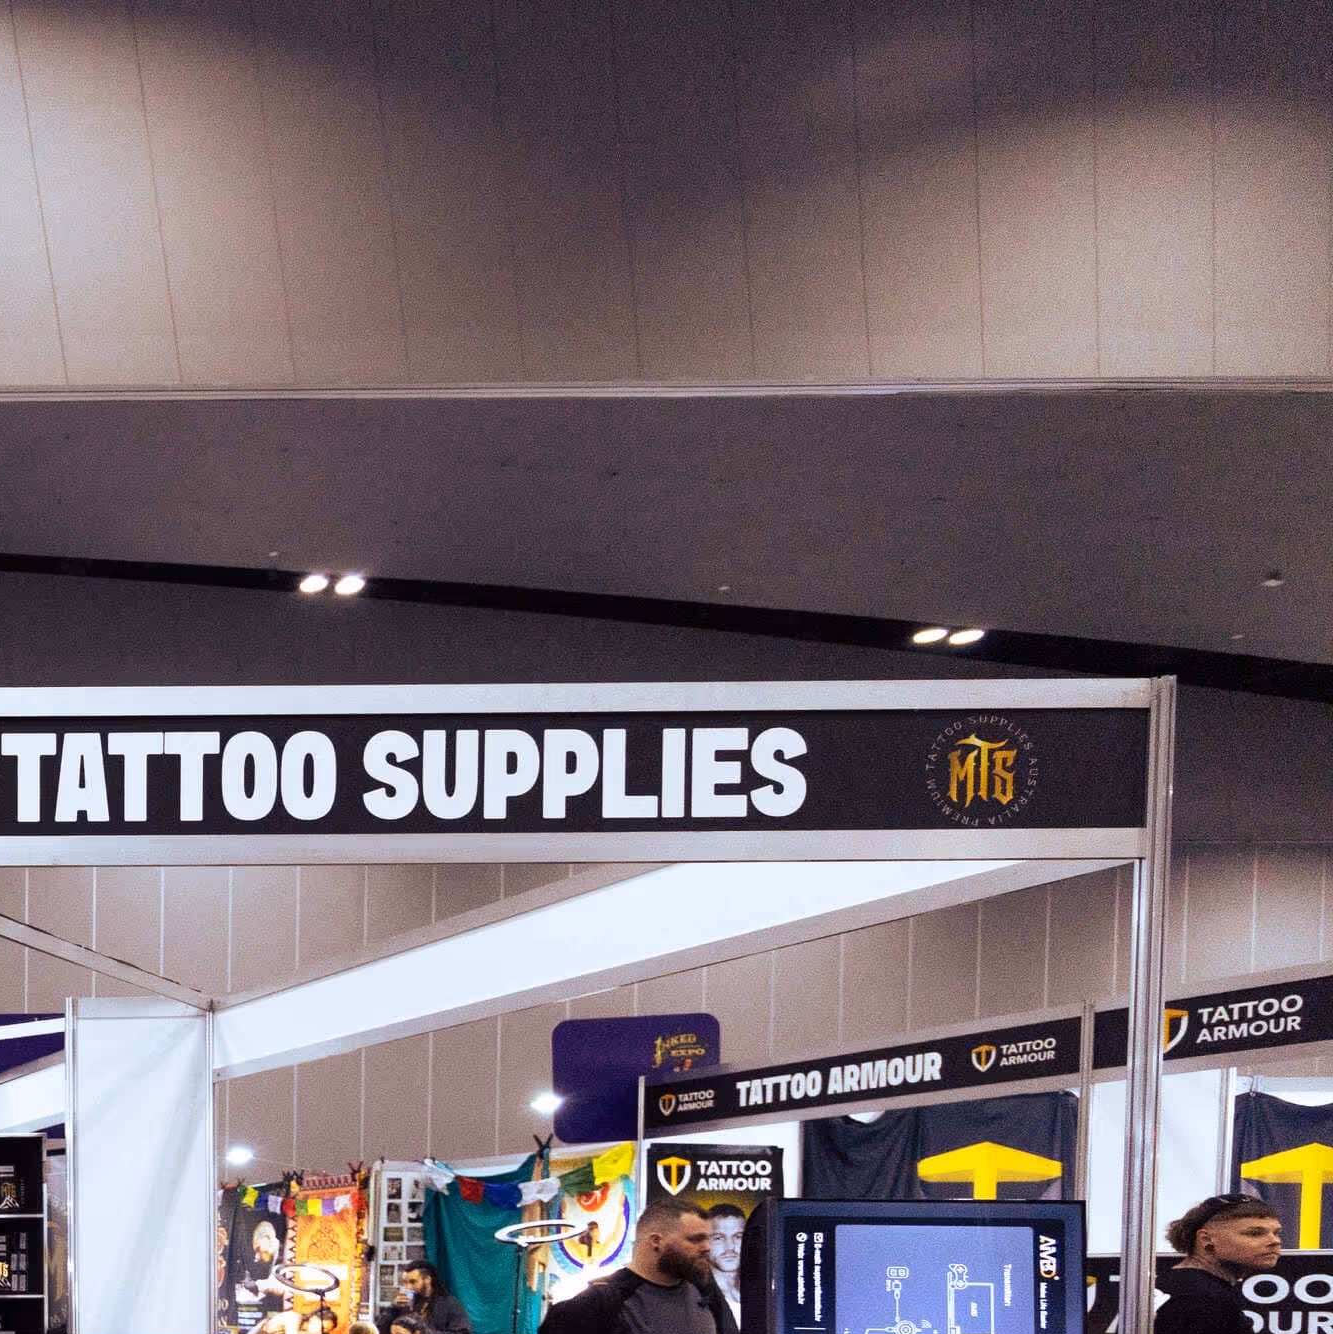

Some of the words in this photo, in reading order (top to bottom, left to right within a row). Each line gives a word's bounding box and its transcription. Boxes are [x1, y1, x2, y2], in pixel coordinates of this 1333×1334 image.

[2, 731, 336, 822] TATTOO
[363, 728, 807, 819] SUPPLIES
[948, 732, 1017, 808] MTS
[1197, 994, 1303, 1026] TATTOO
[1196, 1016, 1302, 1044] ARMOUR
[1000, 1038, 1056, 1055] TATTOO
[1000, 1050, 1055, 1067] ARMOUR
[736, 1076, 822, 1108] TATTOO
[828, 1052, 943, 1095] ARMOUR
[677, 1089, 715, 1103] TATTOO
[677, 1099, 714, 1112] ARMOUR
[697, 1159, 772, 1176] TATTOO
[697, 1175, 772, 1192] ARMOUR
